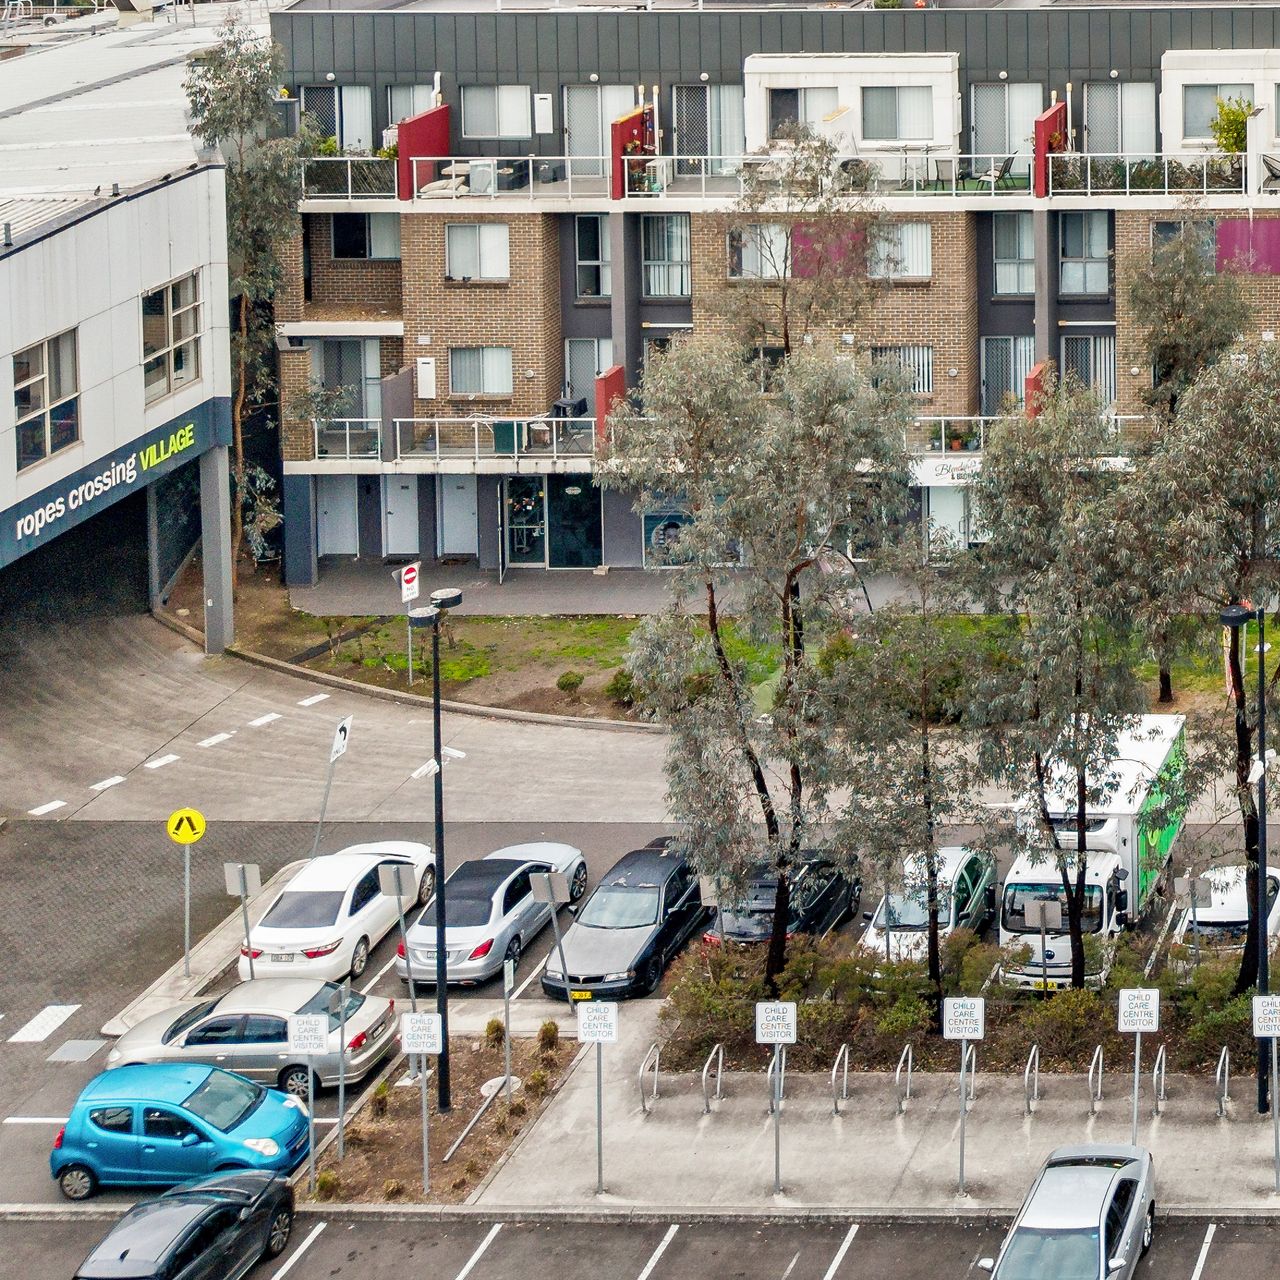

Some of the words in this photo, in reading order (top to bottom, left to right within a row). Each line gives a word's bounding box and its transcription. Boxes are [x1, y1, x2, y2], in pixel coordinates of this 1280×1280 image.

[16, 496, 66, 540] ropes
[68, 453, 137, 510] crossing
[139, 423, 195, 471] VILLAGE
